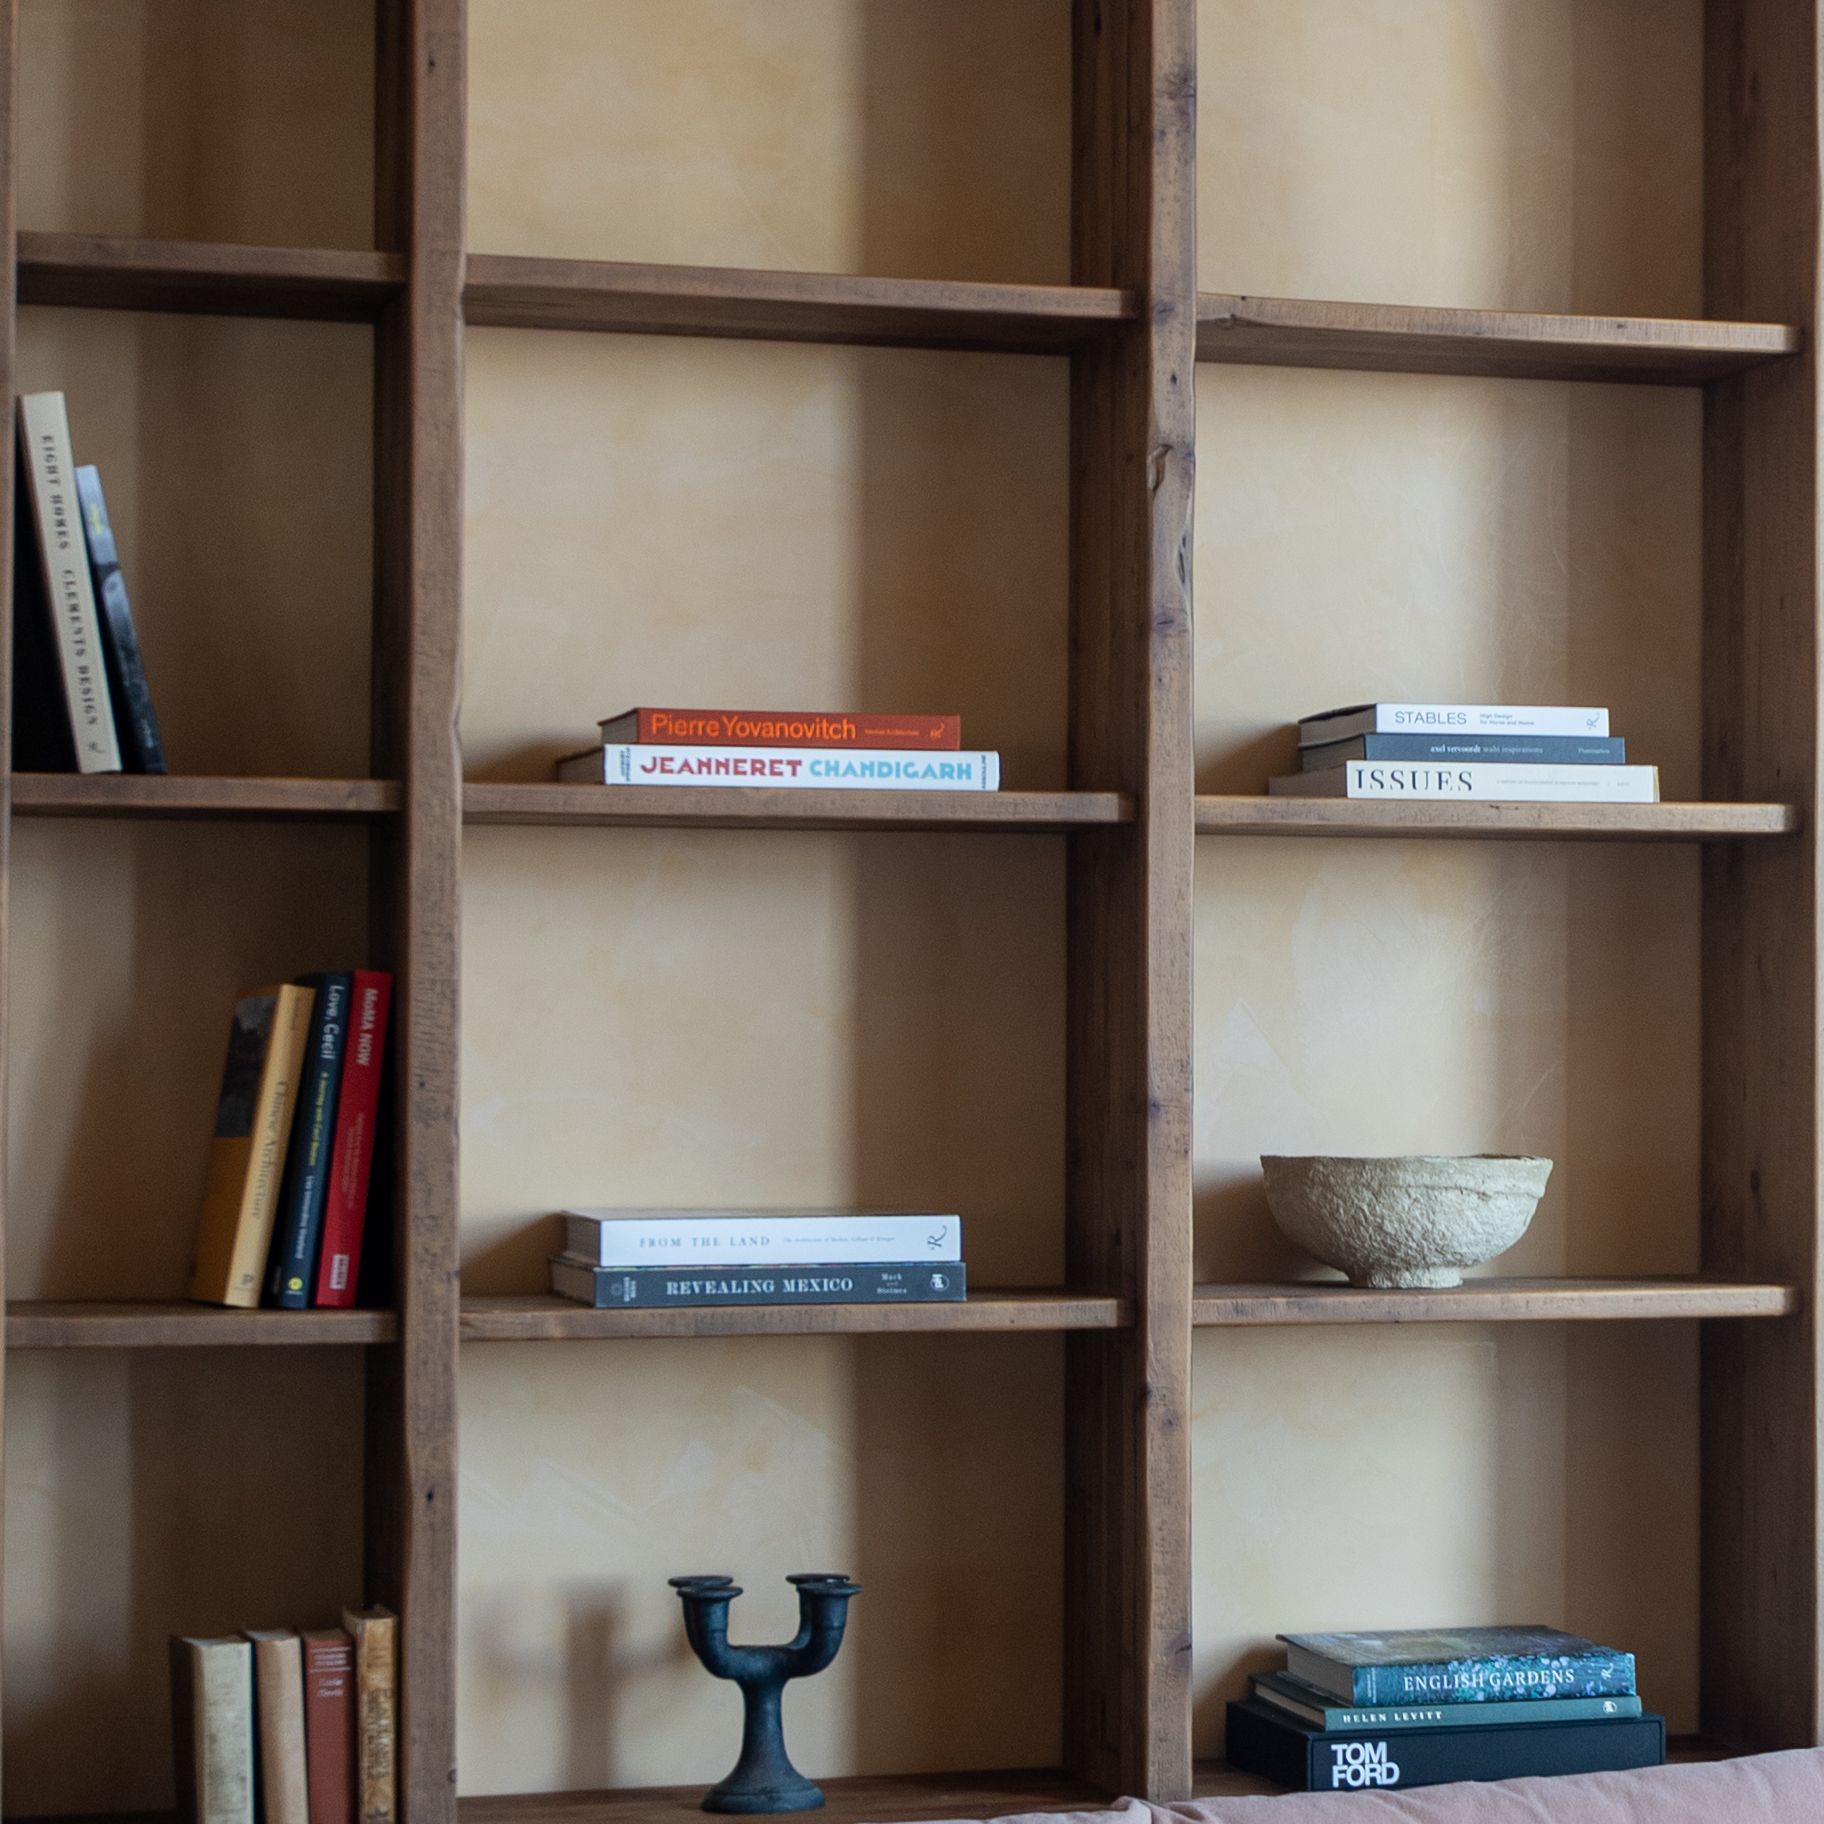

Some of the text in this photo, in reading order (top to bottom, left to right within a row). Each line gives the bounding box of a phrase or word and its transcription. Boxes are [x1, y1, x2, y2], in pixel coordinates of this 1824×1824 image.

[40, 434, 71, 551] EIGHT HOMES
[61, 567, 99, 727] CLEMENTS DESIGN
[651, 713, 857, 741] Pierre Yovanovitch
[1394, 711, 1468, 726] STABLES
[640, 755, 803, 779] JEANNERET
[809, 760, 973, 781] CHANDIGARH
[1355, 768, 1473, 792] ISSUES
[319, 984, 345, 1060] Love, Cecil
[356, 987, 380, 1066] MoMA NOW
[639, 1237, 682, 1248] FROM
[690, 1237, 721, 1248] THE
[730, 1236, 771, 1247] LAND
[666, 1277, 853, 1295] REVEALING MEXICO
[1403, 1668, 1576, 1692] ENGLISH GARDENS
[1342, 1709, 1444, 1725] HELEN LEVITT
[1331, 1741, 1387, 1765] TOM
[1332, 1761, 1400, 1789] FORD
